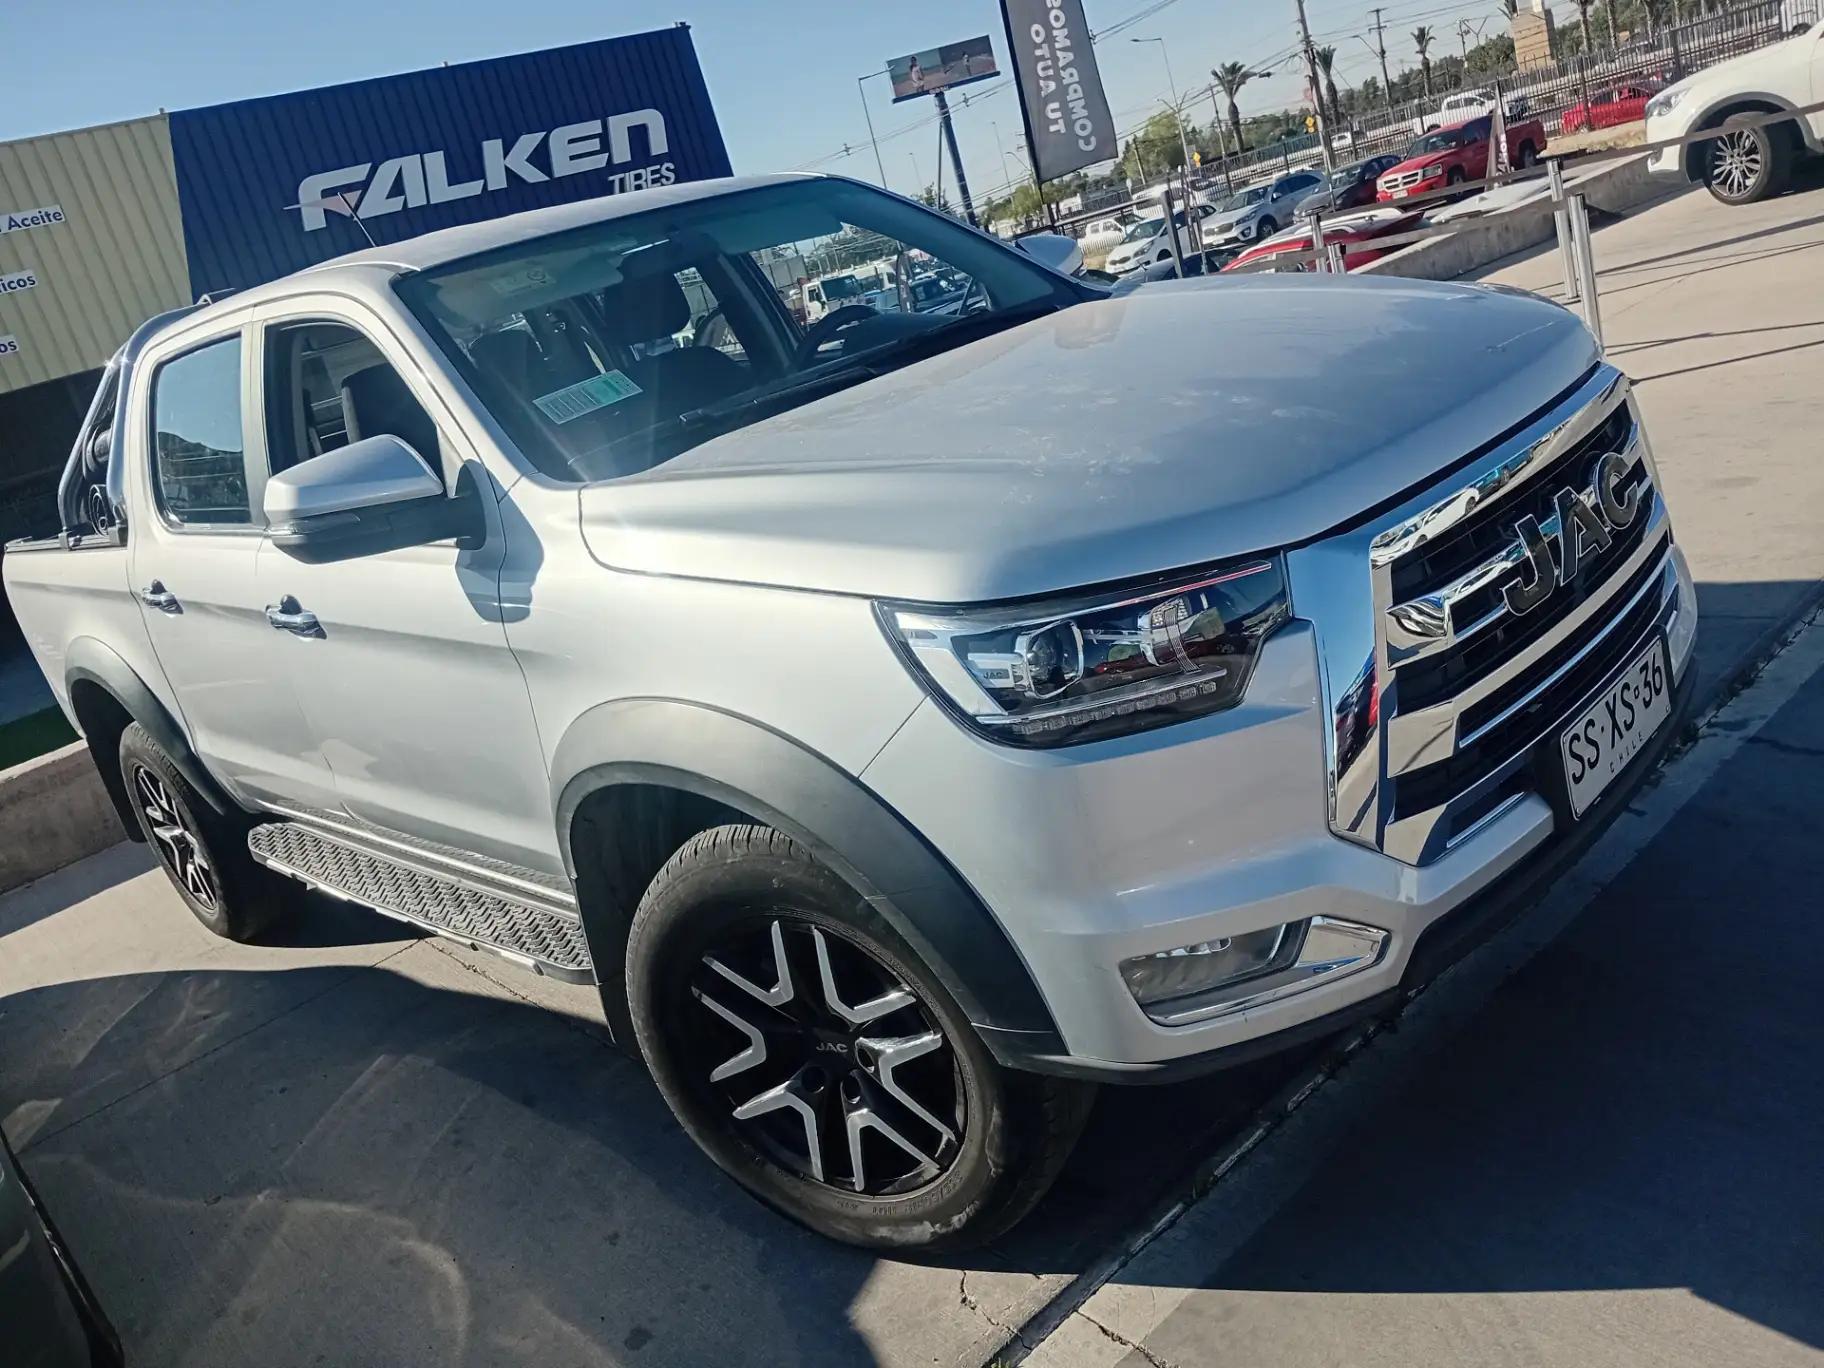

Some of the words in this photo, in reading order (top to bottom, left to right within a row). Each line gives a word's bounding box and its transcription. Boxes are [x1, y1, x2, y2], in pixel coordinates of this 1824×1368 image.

[283, 108, 669, 232] FALKEN
[608, 162, 676, 195] TIRES
[8, 210, 63, 231] Aceite
[0, 275, 36, 293] icos
[1502, 451, 1638, 616] JAC
[1610, 732, 1644, 774] CHILE
[816, 1042, 848, 1053] JAC
